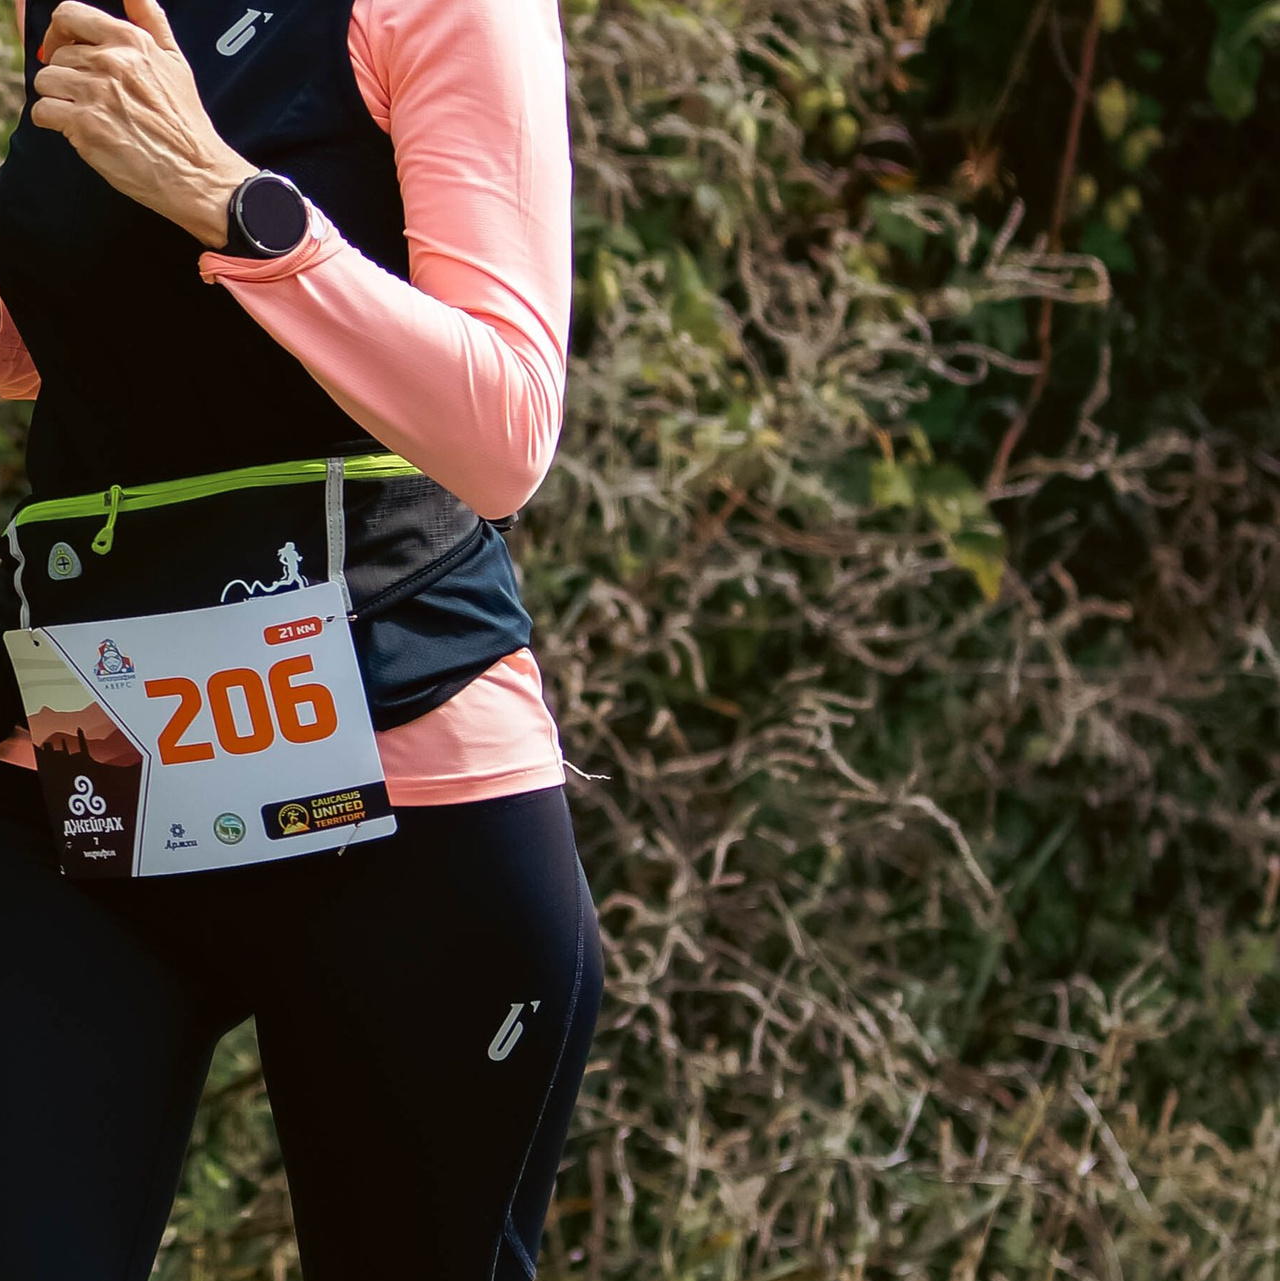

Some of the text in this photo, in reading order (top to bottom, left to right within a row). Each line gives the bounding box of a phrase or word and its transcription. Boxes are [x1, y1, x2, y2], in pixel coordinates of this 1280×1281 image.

[278, 626, 294, 639] 21
[144, 653, 338, 766] 206
[311, 790, 361, 808] CAUCASUS
[312, 799, 364, 819] UNITED
[63, 816, 124, 837] ДЖЕЙРАХ
[314, 811, 366, 828] TERRITORY
